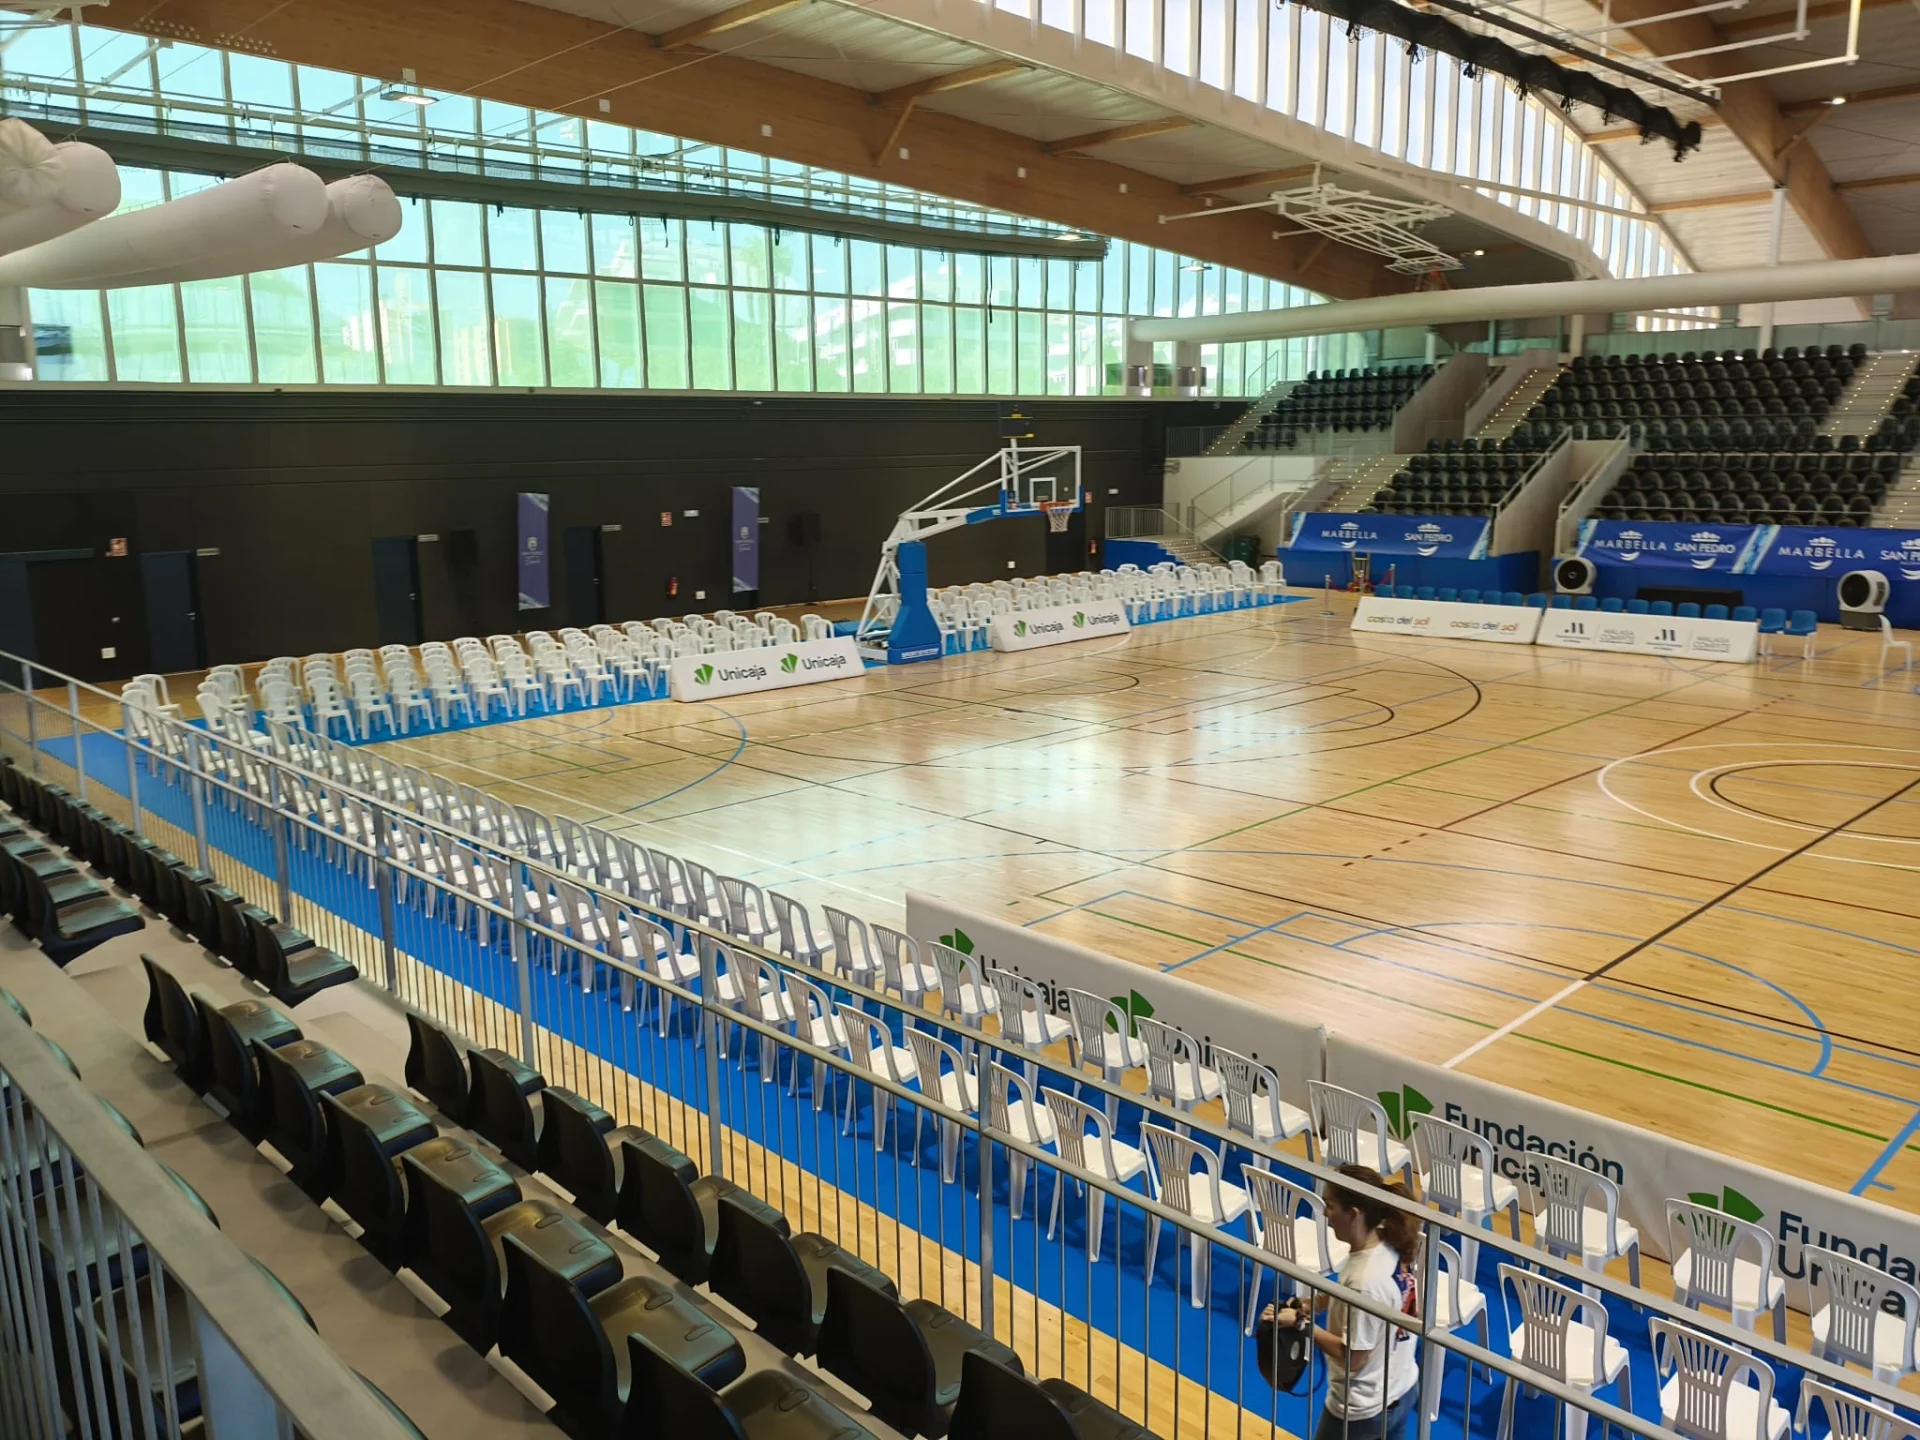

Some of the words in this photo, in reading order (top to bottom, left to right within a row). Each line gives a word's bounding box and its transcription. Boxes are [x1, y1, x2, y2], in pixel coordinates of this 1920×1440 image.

[1321, 530, 1378, 540] MARBELLA
[1404, 532, 1422, 541] SAN
[1424, 534, 1453, 542] PEDRO
[1594, 539, 1667, 551] MARBELLA
[1674, 542, 1699, 553] SAN
[1701, 543, 1736, 554] PEDRO
[1778, 546, 1865, 559] MARBELLA
[1879, 550, 1908, 561] SAN
[1087, 612, 1120, 626] Unicaja
[1414, 617, 1431, 626] sol
[1028, 621, 1064, 635] Unicaja
[1501, 622, 1519, 632] sol
[801, 653, 847, 670] Unicaja
[717, 664, 767, 681] Unicaja
[1445, 1102, 1624, 1186] Fundación
[1778, 1210, 1920, 1287] Funda
